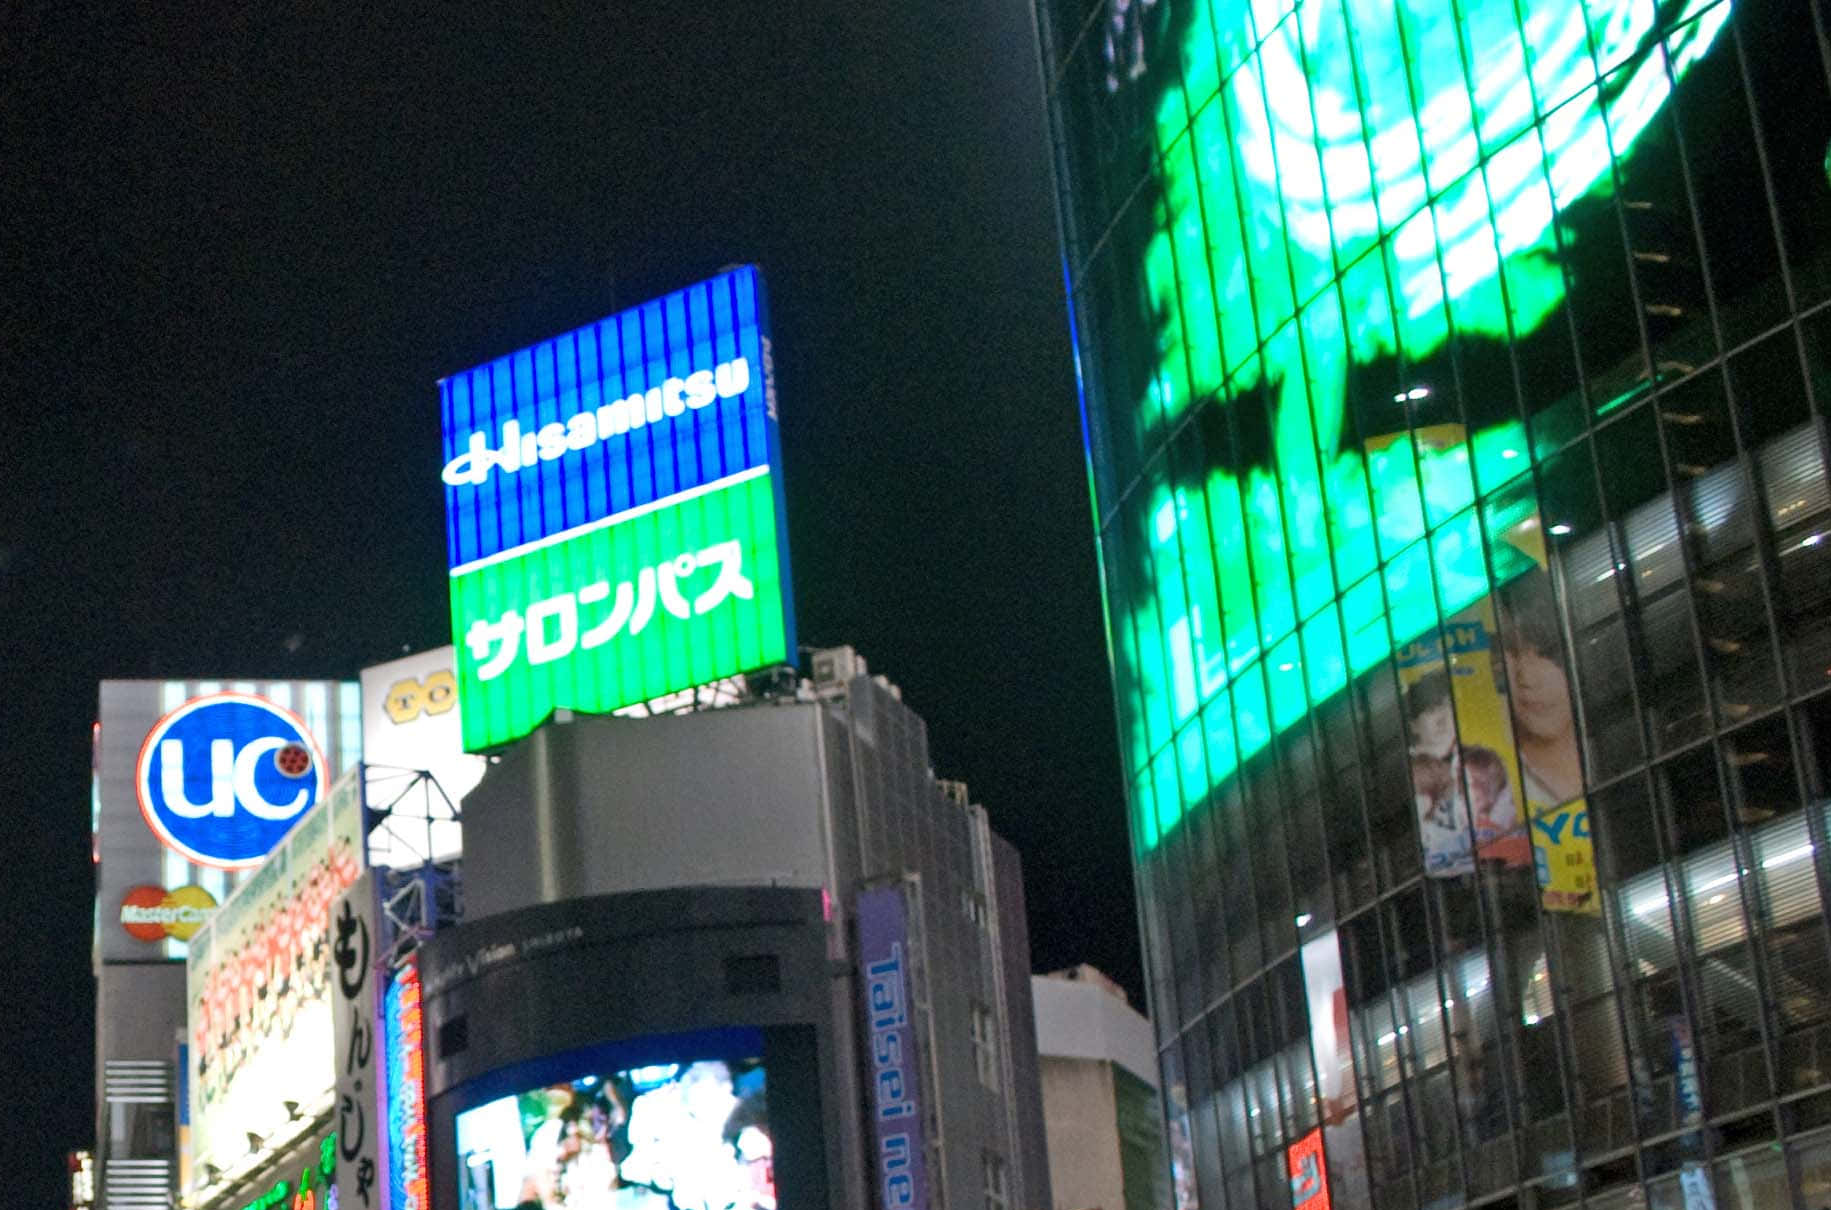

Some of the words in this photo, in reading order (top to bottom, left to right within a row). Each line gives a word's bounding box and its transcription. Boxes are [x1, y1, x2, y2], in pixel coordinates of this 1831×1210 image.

[464, 538, 756, 682] サロンパス
[867, 941, 917, 1123] Taisei
